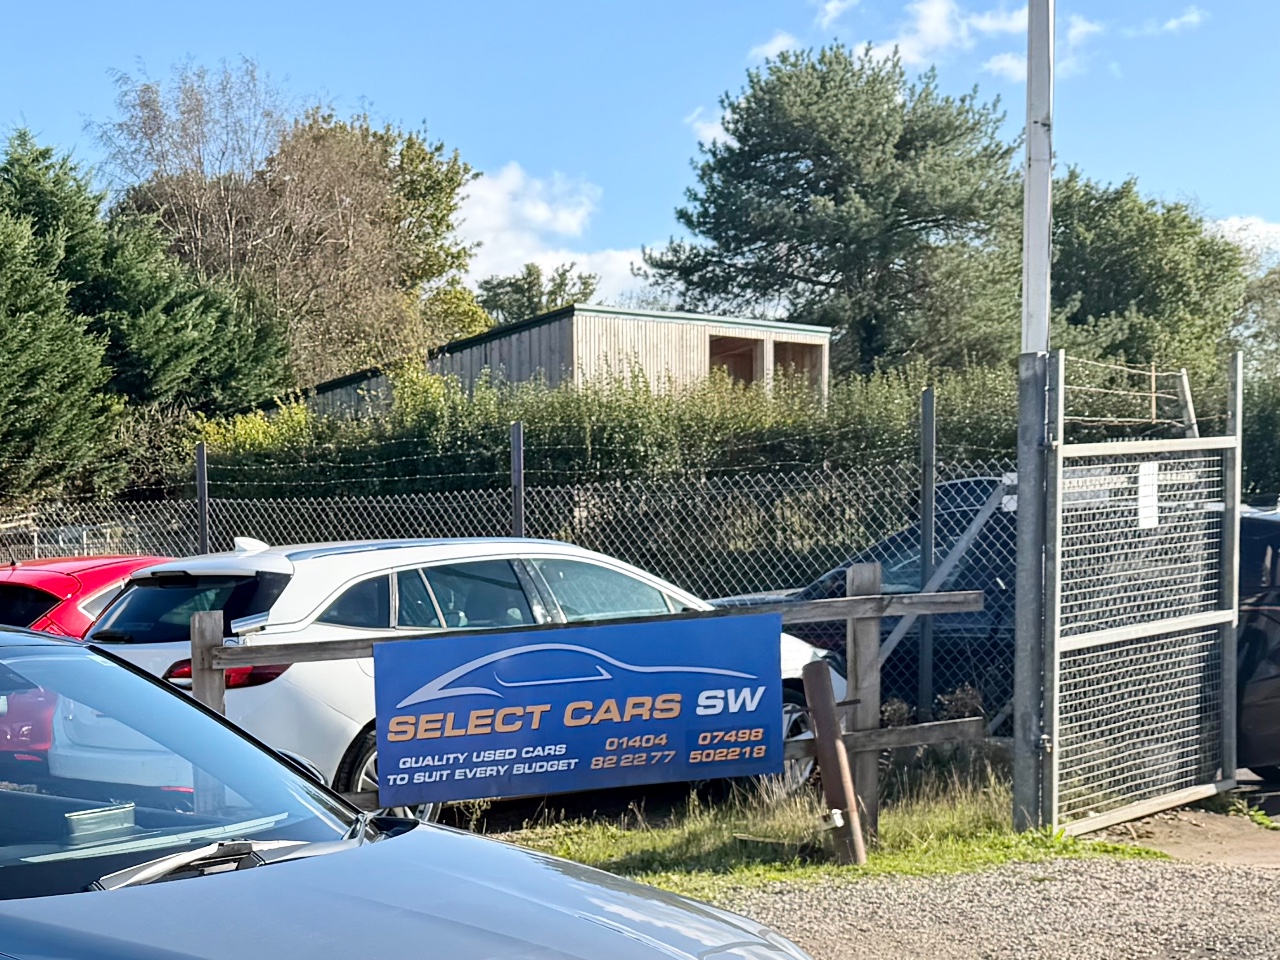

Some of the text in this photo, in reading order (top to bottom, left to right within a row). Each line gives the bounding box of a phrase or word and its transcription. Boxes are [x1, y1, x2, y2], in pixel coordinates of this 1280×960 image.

[387, 686, 766, 742] SELECT CARS SW
[605, 733, 668, 751] 01404
[698, 728, 765, 745] 07498
[398, 744, 567, 769] QUALITY USED CARS
[689, 745, 766, 763] 502218
[387, 758, 579, 786] TO SUIT EVERY BUDGET
